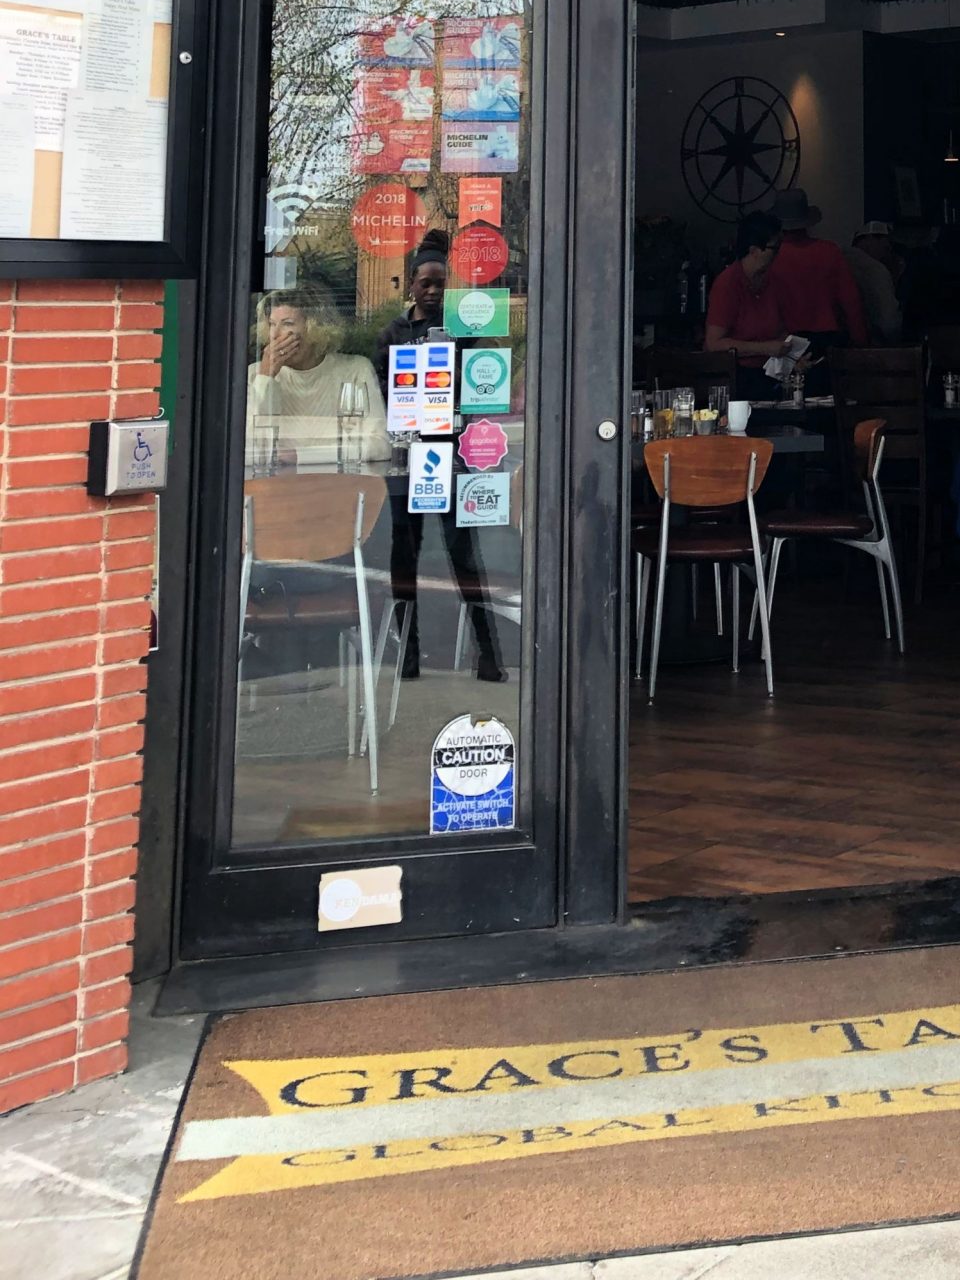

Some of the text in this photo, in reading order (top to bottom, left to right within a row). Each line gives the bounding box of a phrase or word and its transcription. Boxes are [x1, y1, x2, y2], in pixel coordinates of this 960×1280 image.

[52, 33, 77, 44] TABLE
[375, 193, 407, 204] 2018
[352, 215, 427, 227] MICHELIN
[263, 225, 320, 236] Free WiFi
[458, 246, 501, 263] 2018
[396, 395, 415, 403] VISA
[427, 396, 448, 404] VISA
[131, 463, 152, 471] PUSH
[137, 471, 156, 479] OPEN
[414, 483, 444, 495] BBB
[477, 494, 502, 505] EAT
[446, 734, 502, 746] AUTOMATIC
[442, 747, 506, 765] CAUTION
[459, 768, 488, 779] DOOR
[437, 799, 509, 811] ACTIVATE SWITCH
[460, 812, 498, 822] OPERATE
[279, 1027, 769, 1109] GRACE'S
[281, 1113, 712, 1167] GLOBAL
